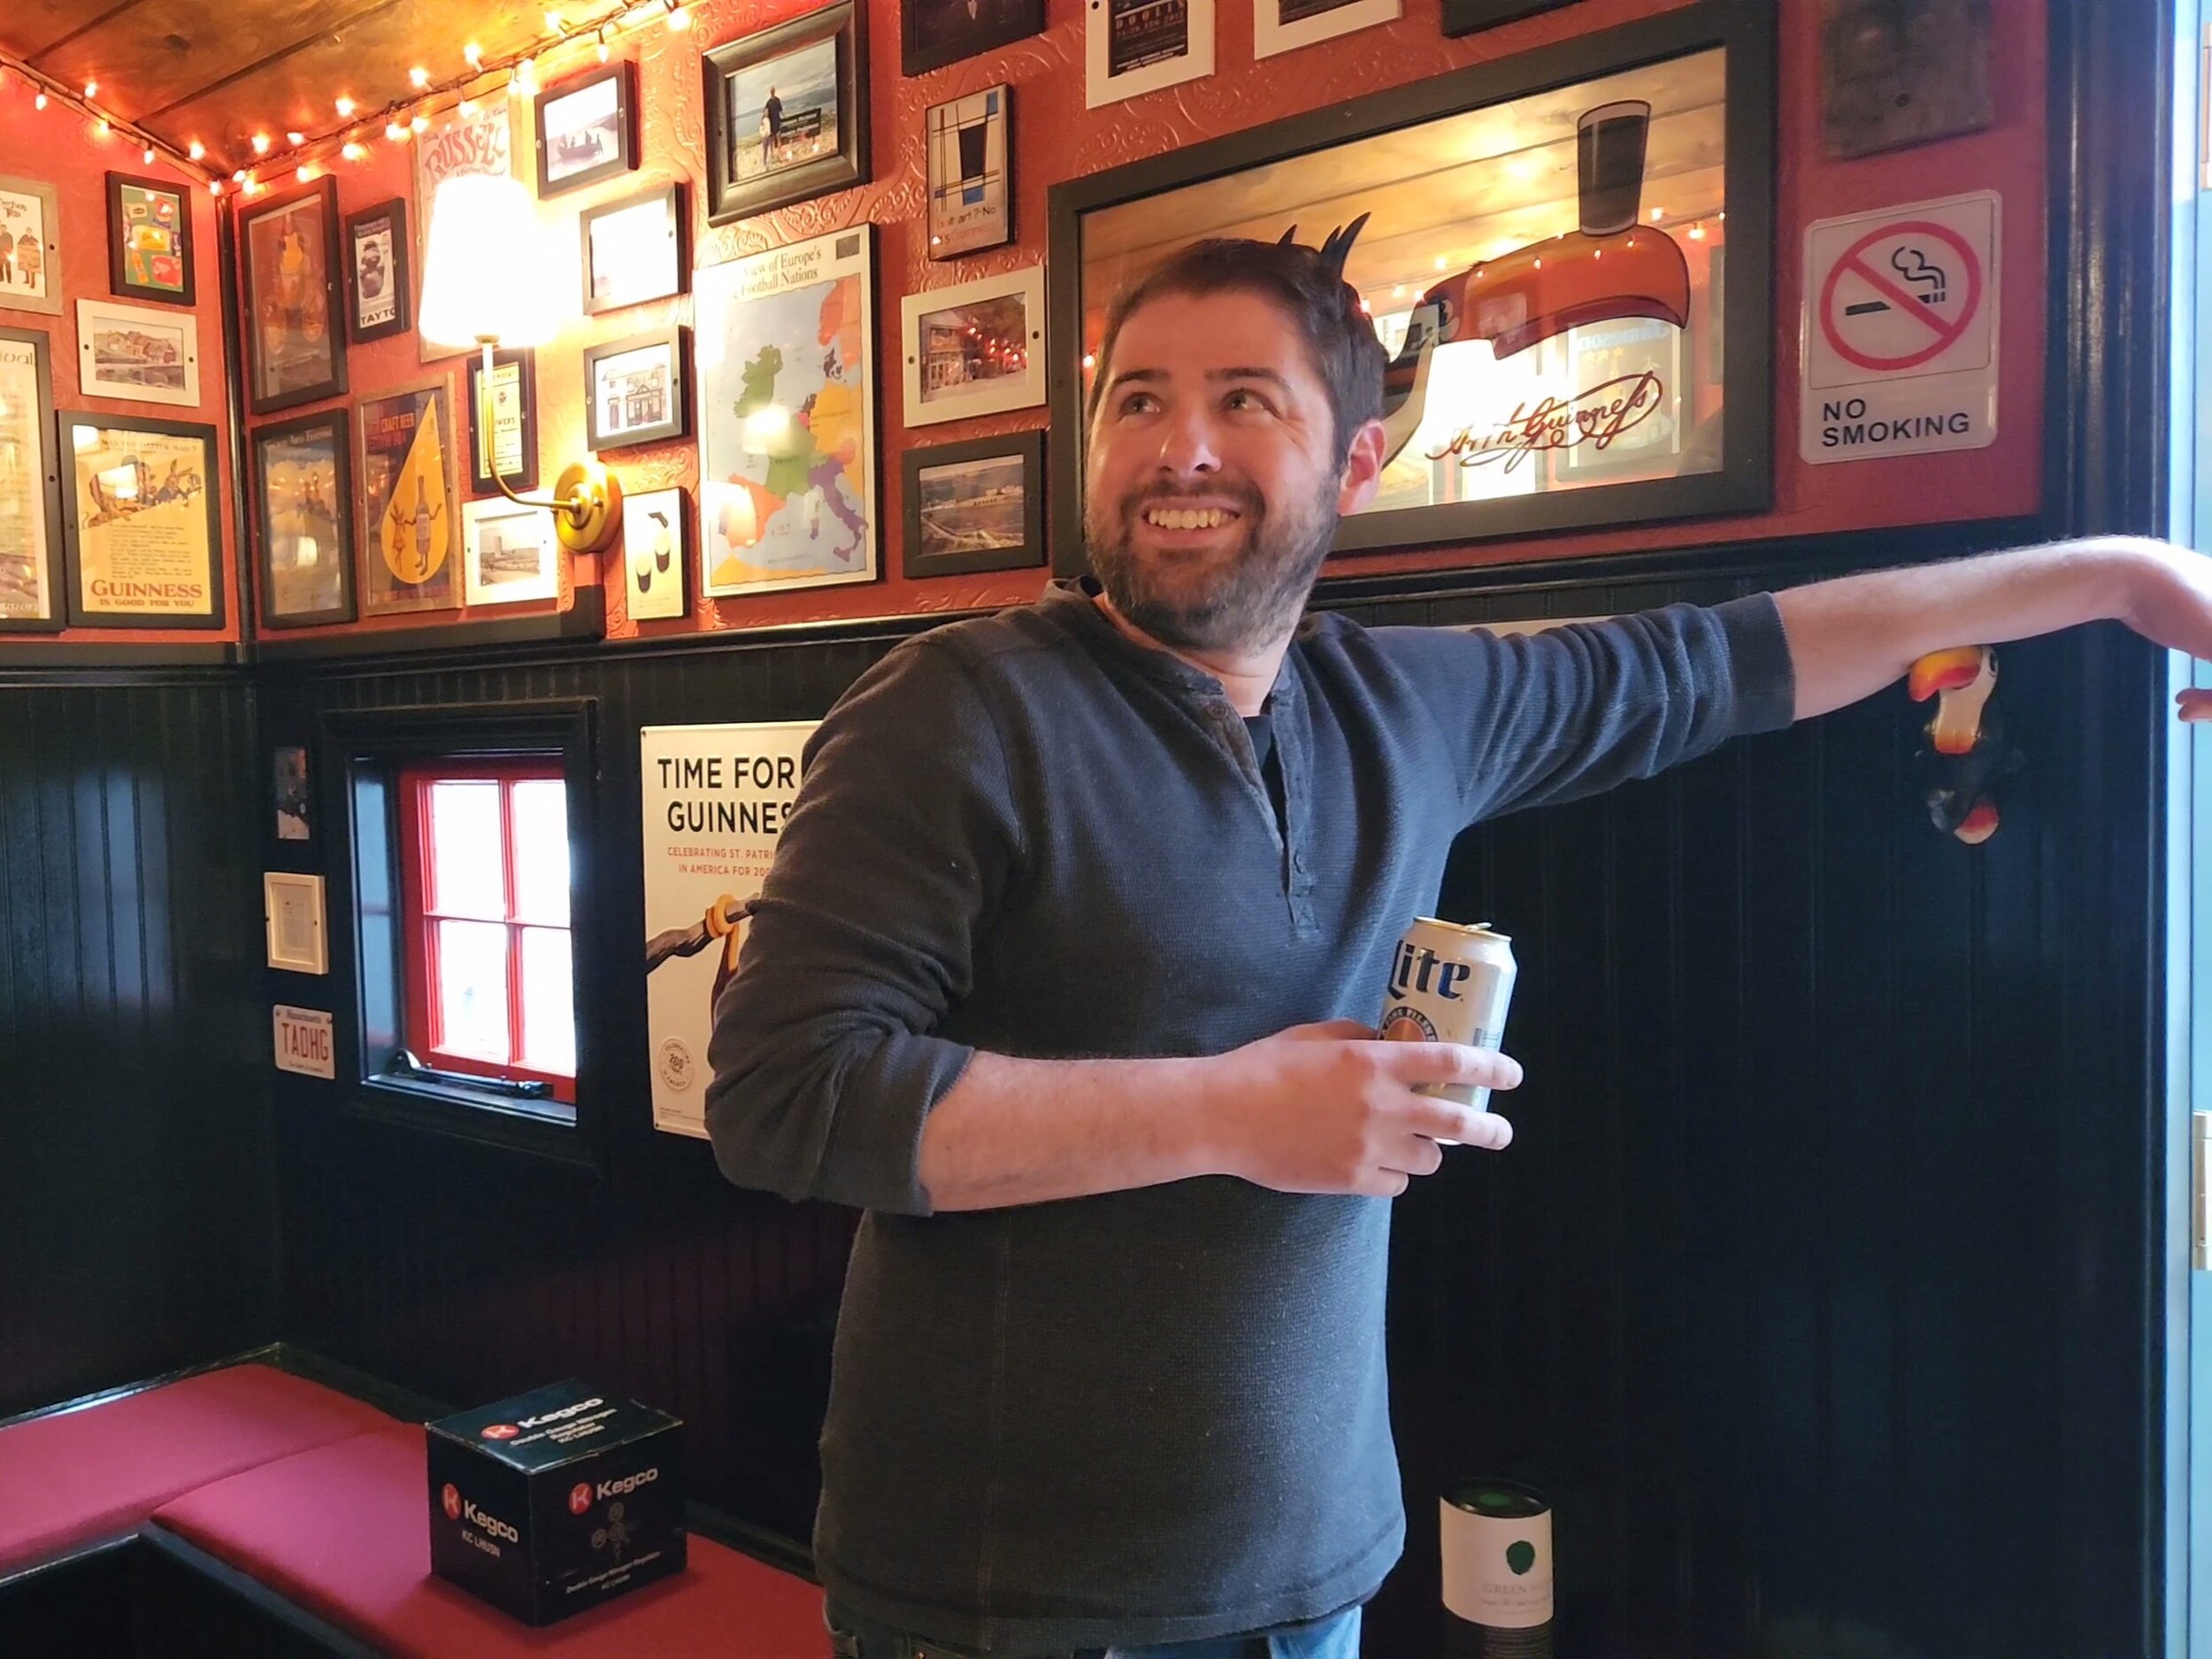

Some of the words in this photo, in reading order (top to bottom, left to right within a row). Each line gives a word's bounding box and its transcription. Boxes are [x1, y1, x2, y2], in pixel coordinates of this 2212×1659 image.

[769, 256, 779, 271] of
[780, 246, 822, 268] Europe's
[780, 267, 818, 287] Nations
[1823, 398, 1866, 422] NO
[1822, 412, 1970, 448] SMOKING
[90, 580, 203, 598] GUINNESS
[657, 757, 722, 788] TIME
[734, 757, 795, 788] FOR
[668, 801, 793, 833] GUINNES
[667, 847, 726, 858] CELEBRATING
[730, 849, 743, 858] ST.
[746, 849, 773, 859] PATRI
[679, 864, 687, 873] IN
[690, 864, 730, 875] AMERICA
[733, 866, 751, 876] FOR
[1387, 939, 1471, 1001] Lite
[281, 1022, 328, 1061] TADHG
[517, 1397, 604, 1428] Kegco
[596, 1468, 658, 1501] Kegco
[462, 1529, 473, 1544] KC
[464, 1499, 519, 1544] Kegco
